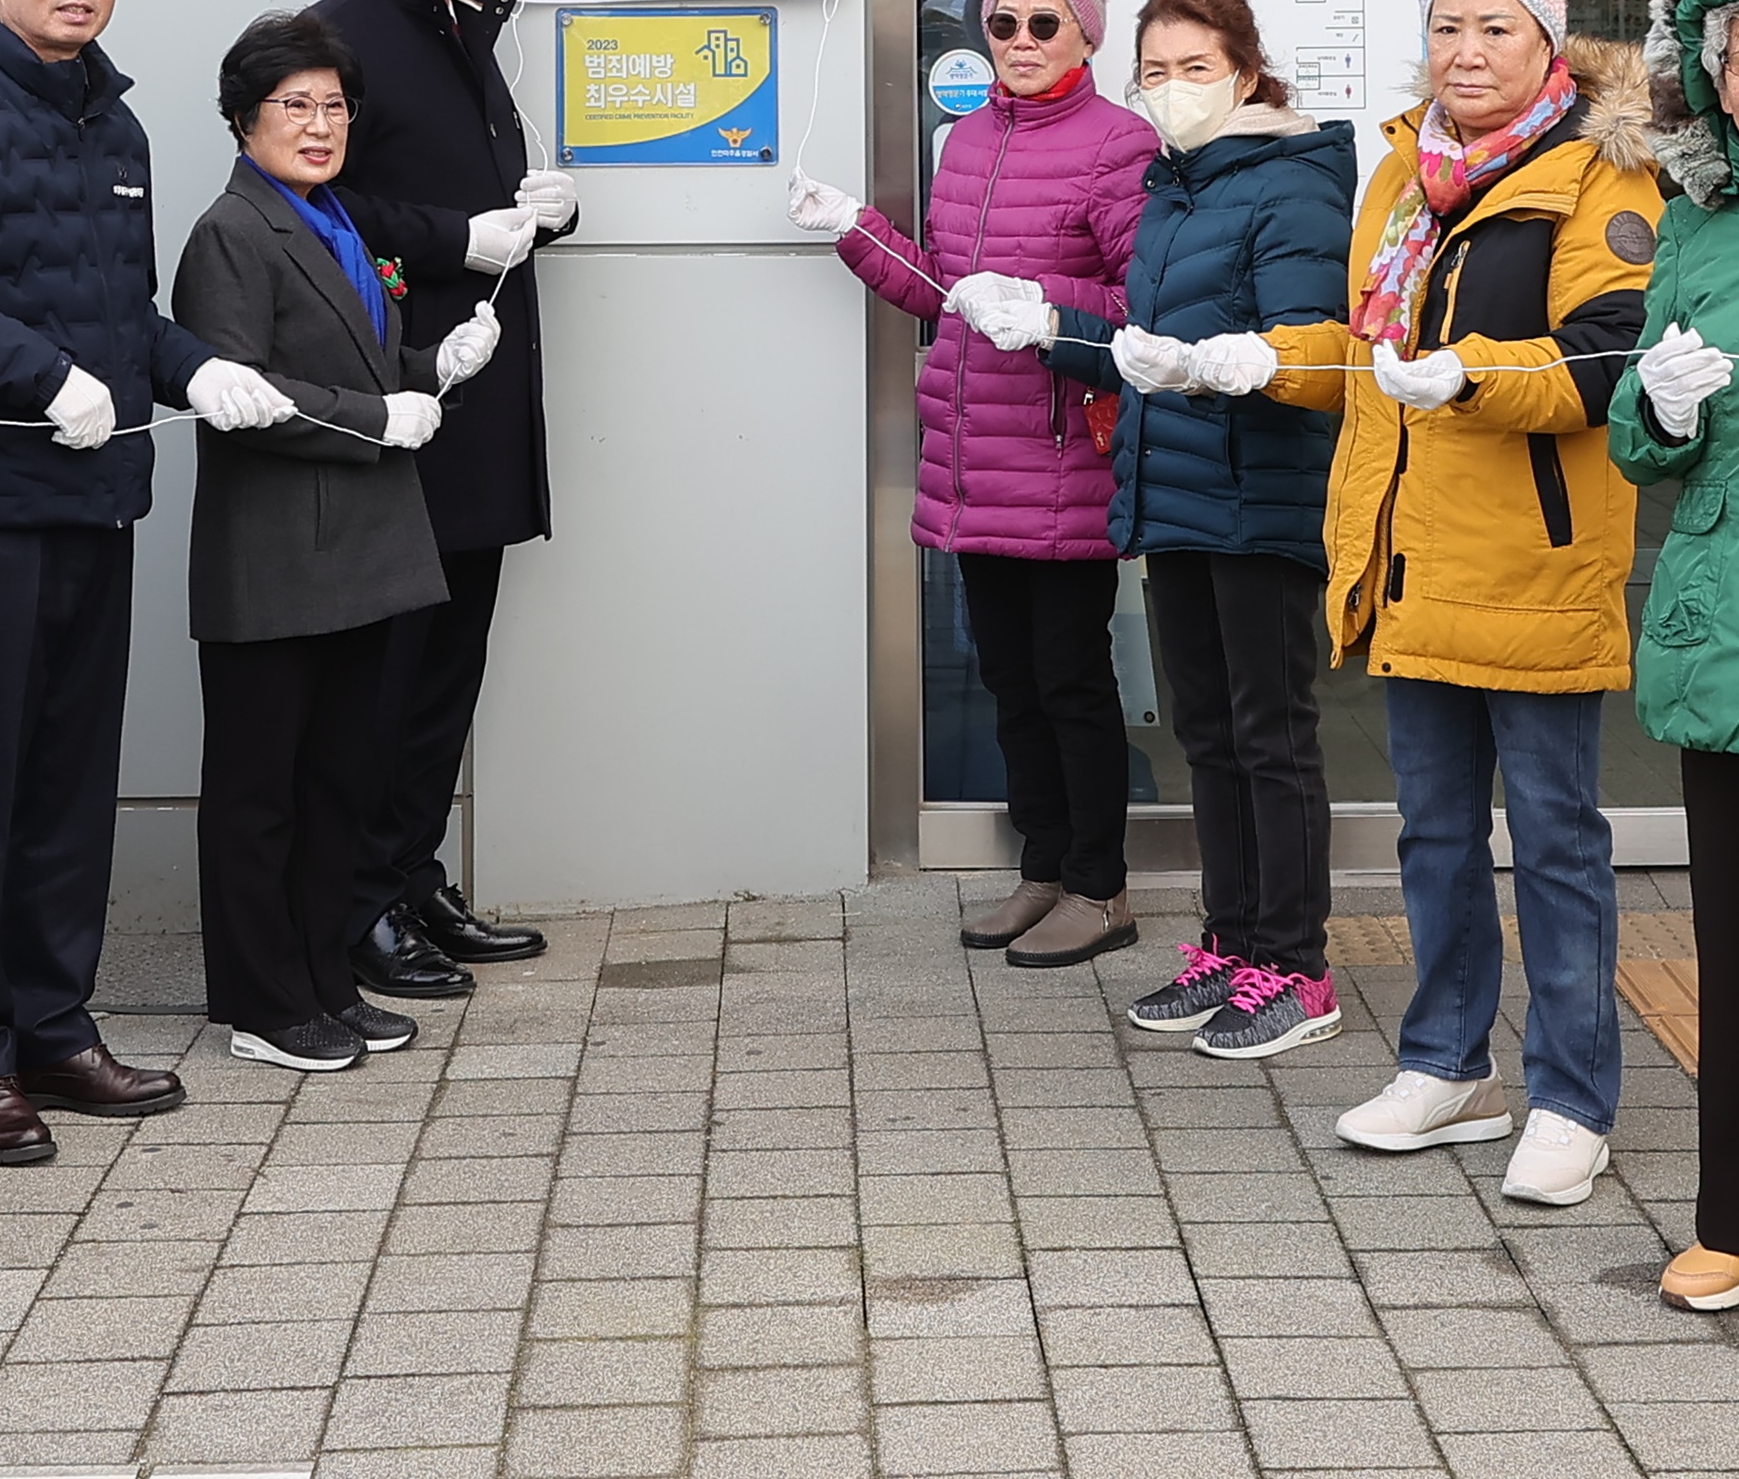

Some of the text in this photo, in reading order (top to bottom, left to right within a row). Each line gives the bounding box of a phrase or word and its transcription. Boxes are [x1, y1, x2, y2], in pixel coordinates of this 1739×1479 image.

[586, 39, 619, 51] 2023
[584, 53, 674, 79] 범죄예방
[585, 82, 697, 109] 최우수시설
